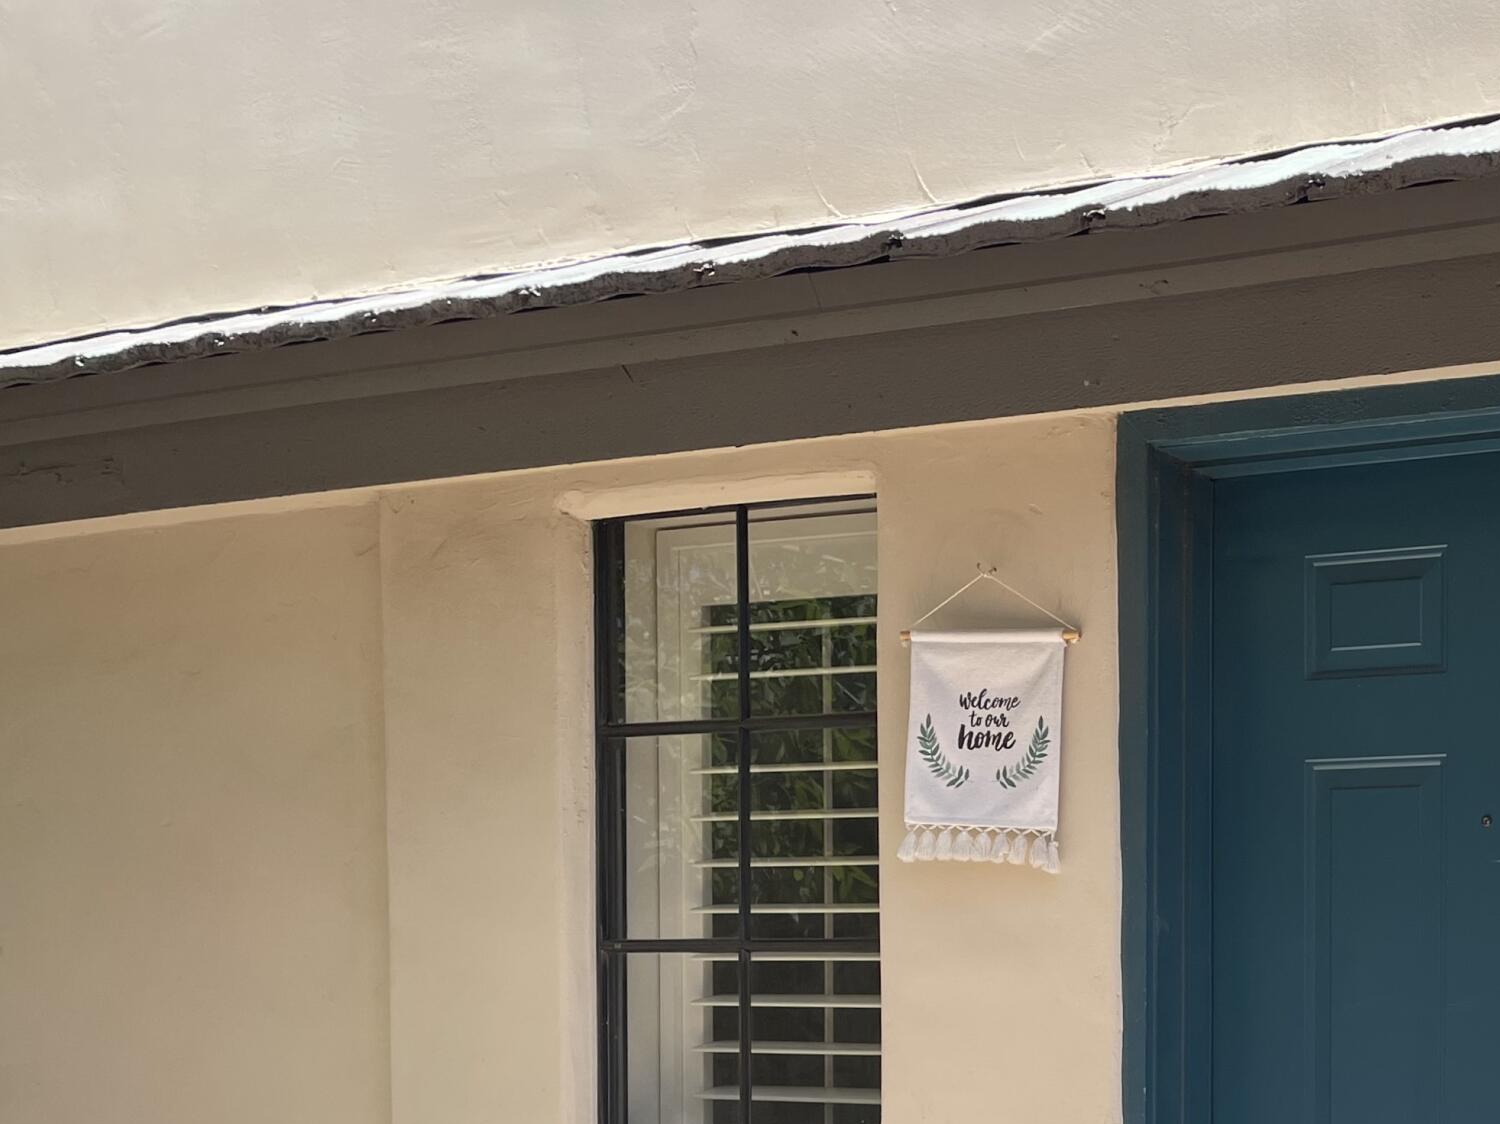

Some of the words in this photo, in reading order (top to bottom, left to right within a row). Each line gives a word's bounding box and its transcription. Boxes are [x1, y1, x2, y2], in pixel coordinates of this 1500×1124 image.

[969, 710, 983, 727] to
[985, 713, 1010, 727] our
[958, 723, 1016, 751] home
